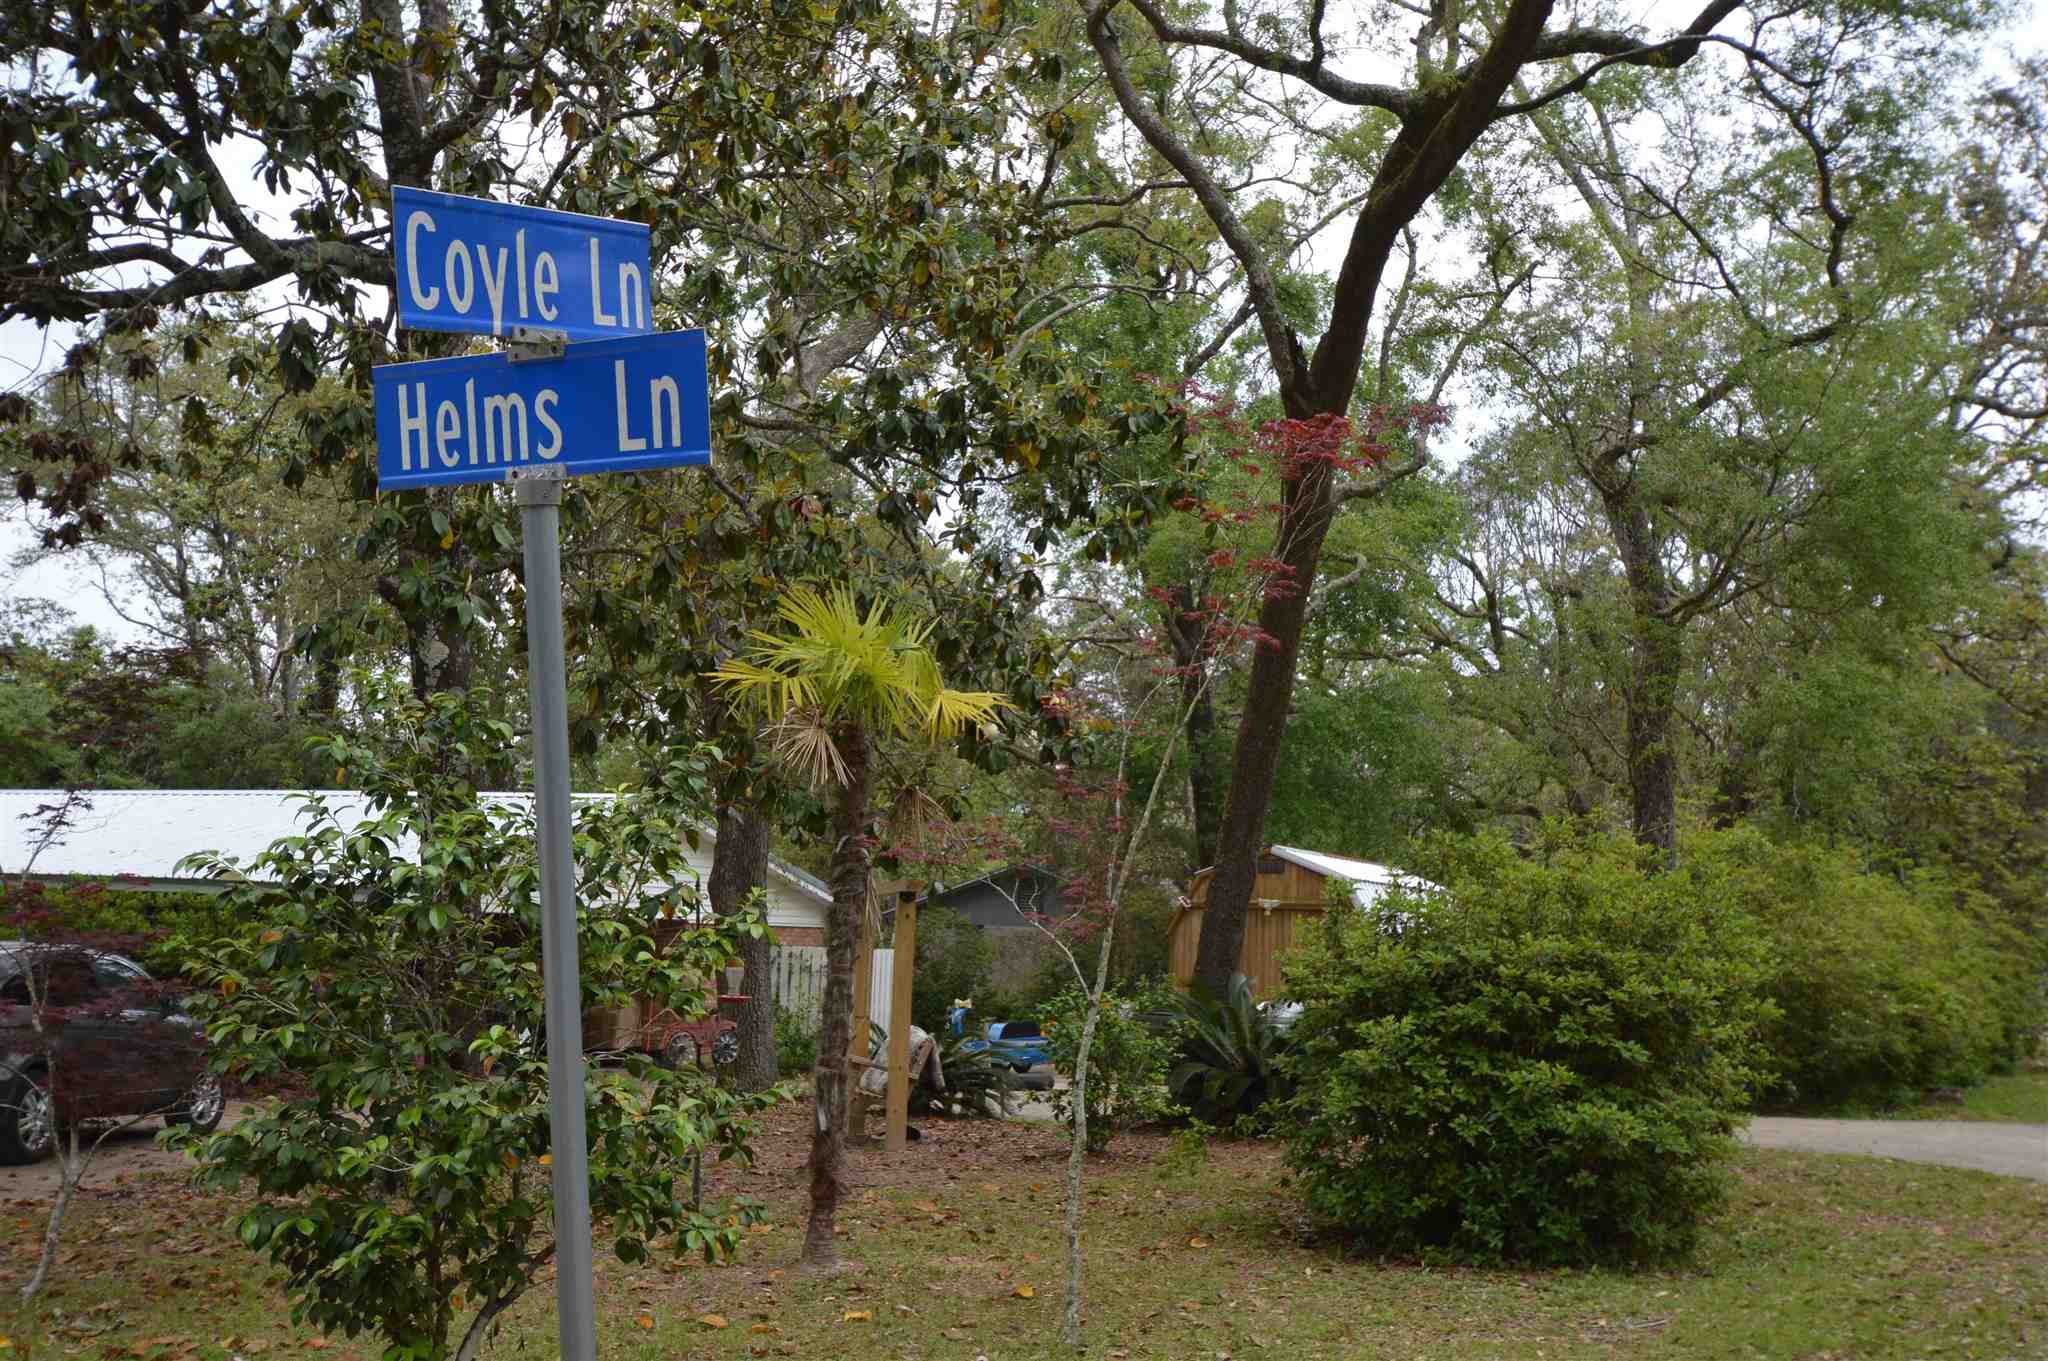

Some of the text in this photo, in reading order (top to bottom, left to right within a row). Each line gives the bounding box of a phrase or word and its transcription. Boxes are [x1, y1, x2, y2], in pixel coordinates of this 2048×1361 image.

[406, 210, 645, 336] Coyle Ln
[398, 359, 681, 470] Helms Ln
